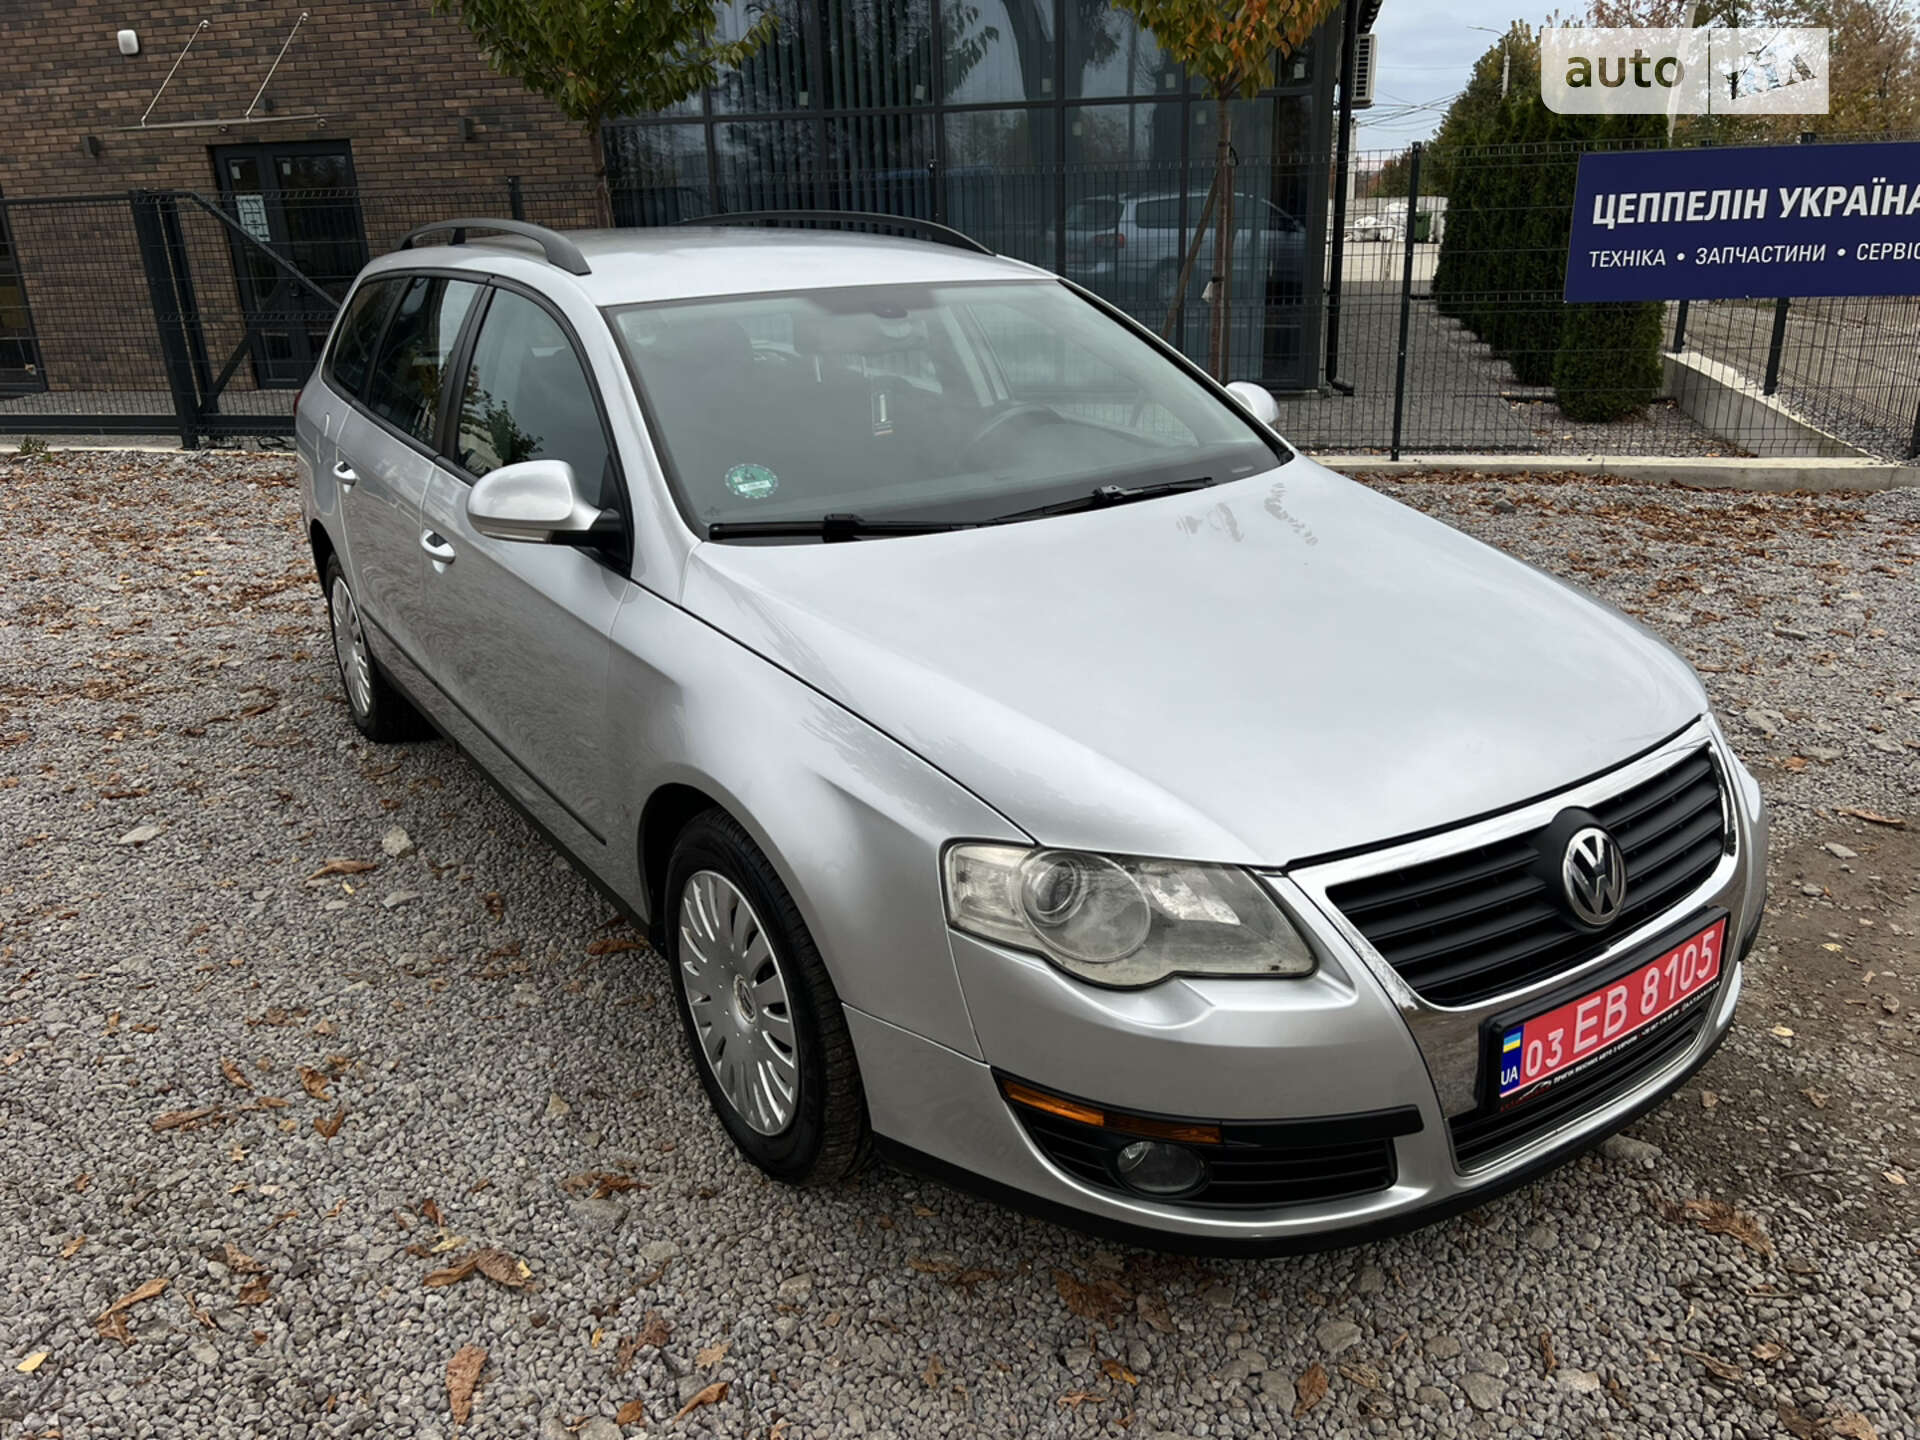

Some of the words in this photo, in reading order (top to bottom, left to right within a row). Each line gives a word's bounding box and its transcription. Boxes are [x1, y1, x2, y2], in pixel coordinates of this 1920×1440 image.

[1592, 188, 1768, 230] ЦЕППЕЛІН
[1589, 248, 1666, 268] ТЕХНІКА
[1695, 243, 1827, 265] ЗАПЧАСТИНИ
[1525, 1027, 1564, 1078] 03
[1572, 984, 1629, 1055] EB
[1639, 929, 1716, 1016] 8105
[1500, 1064, 1519, 1087] UA
